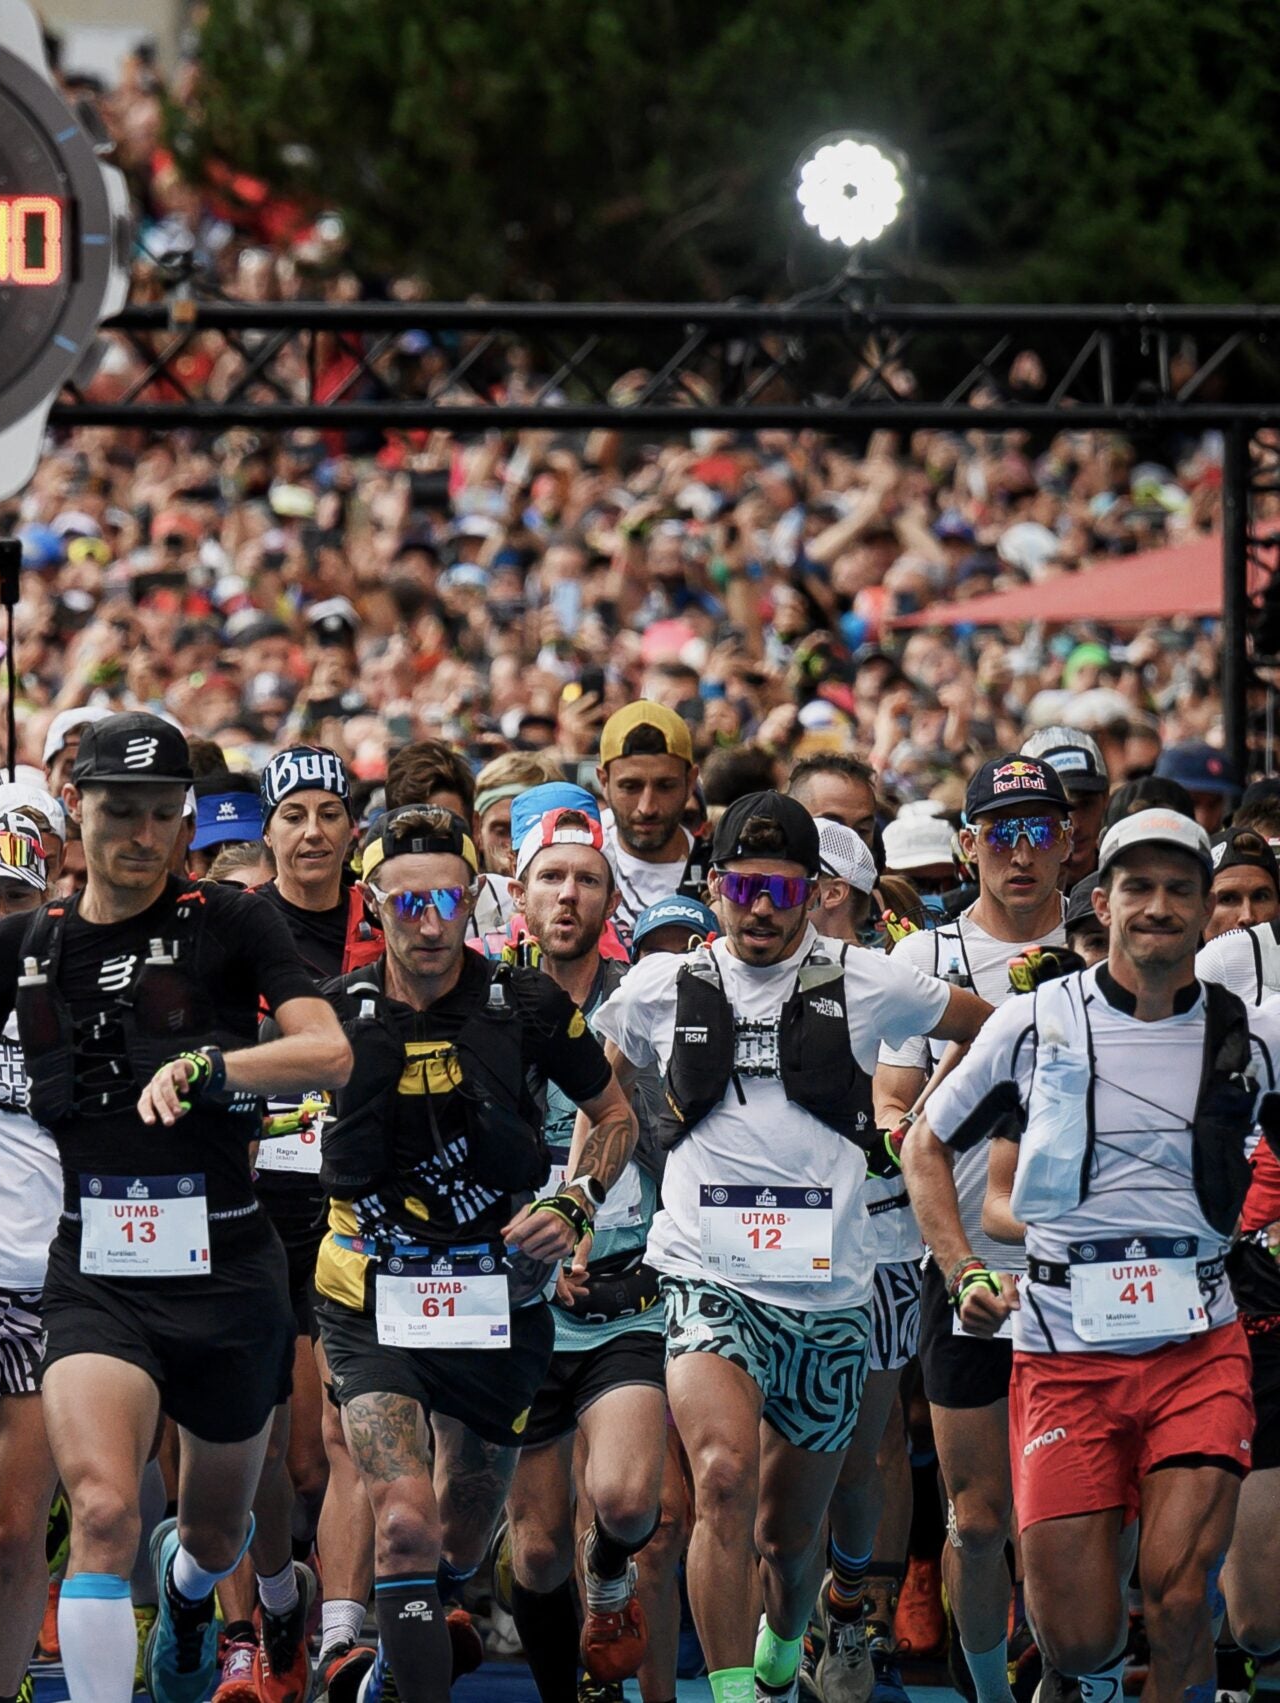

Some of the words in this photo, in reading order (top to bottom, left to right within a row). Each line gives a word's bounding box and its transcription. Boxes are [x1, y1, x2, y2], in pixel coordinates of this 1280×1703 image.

[271, 752, 345, 801] Buff
[994, 776, 1020, 794] Red
[1022, 776, 1047, 791] Bull
[648, 905, 704, 924] HOKA
[685, 1033, 707, 1043] RSM
[276, 1148, 298, 1156] Ragna
[114, 1205, 159, 1218] UTMB
[742, 1213, 786, 1225] UTMB
[121, 1221, 156, 1243] 13
[747, 1228, 782, 1249] 12
[1112, 1264, 1158, 1280] UTMB
[417, 1282, 463, 1294] UTMB
[1120, 1281, 1155, 1304] 41
[422, 1297, 455, 1317] 61
[1024, 1427, 1066, 1456] omon
